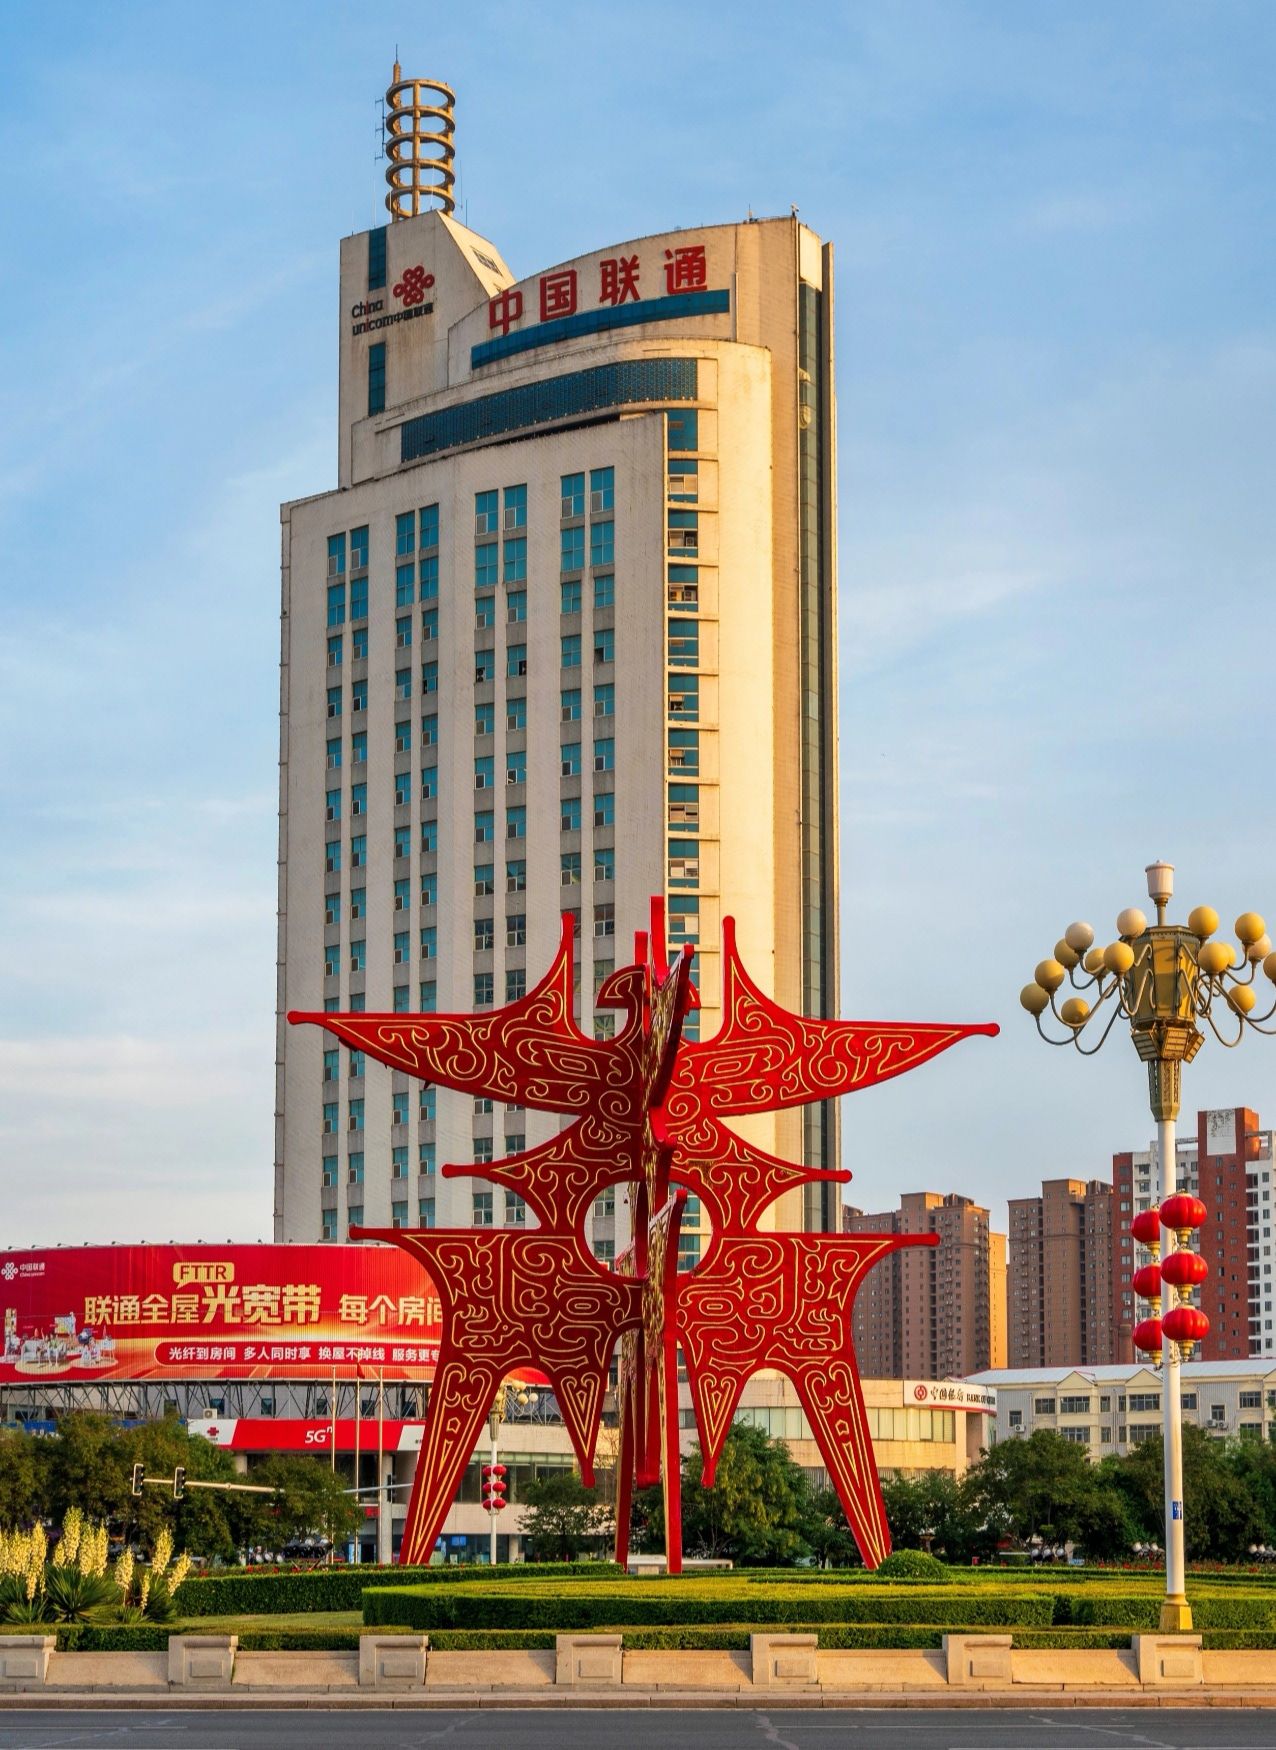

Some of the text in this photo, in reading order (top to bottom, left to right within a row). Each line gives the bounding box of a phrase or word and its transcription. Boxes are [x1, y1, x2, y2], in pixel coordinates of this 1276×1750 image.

[488, 245, 707, 336] 中国联通
[351, 300, 384, 318] China
[352, 314, 394, 336] unicom
[180, 1265, 227, 1280] FTTR
[84, 1284, 322, 1325] 联通全屋光宽带
[169, 1346, 236, 1361] 光纤到房间
[244, 1346, 311, 1361] 多人同时享
